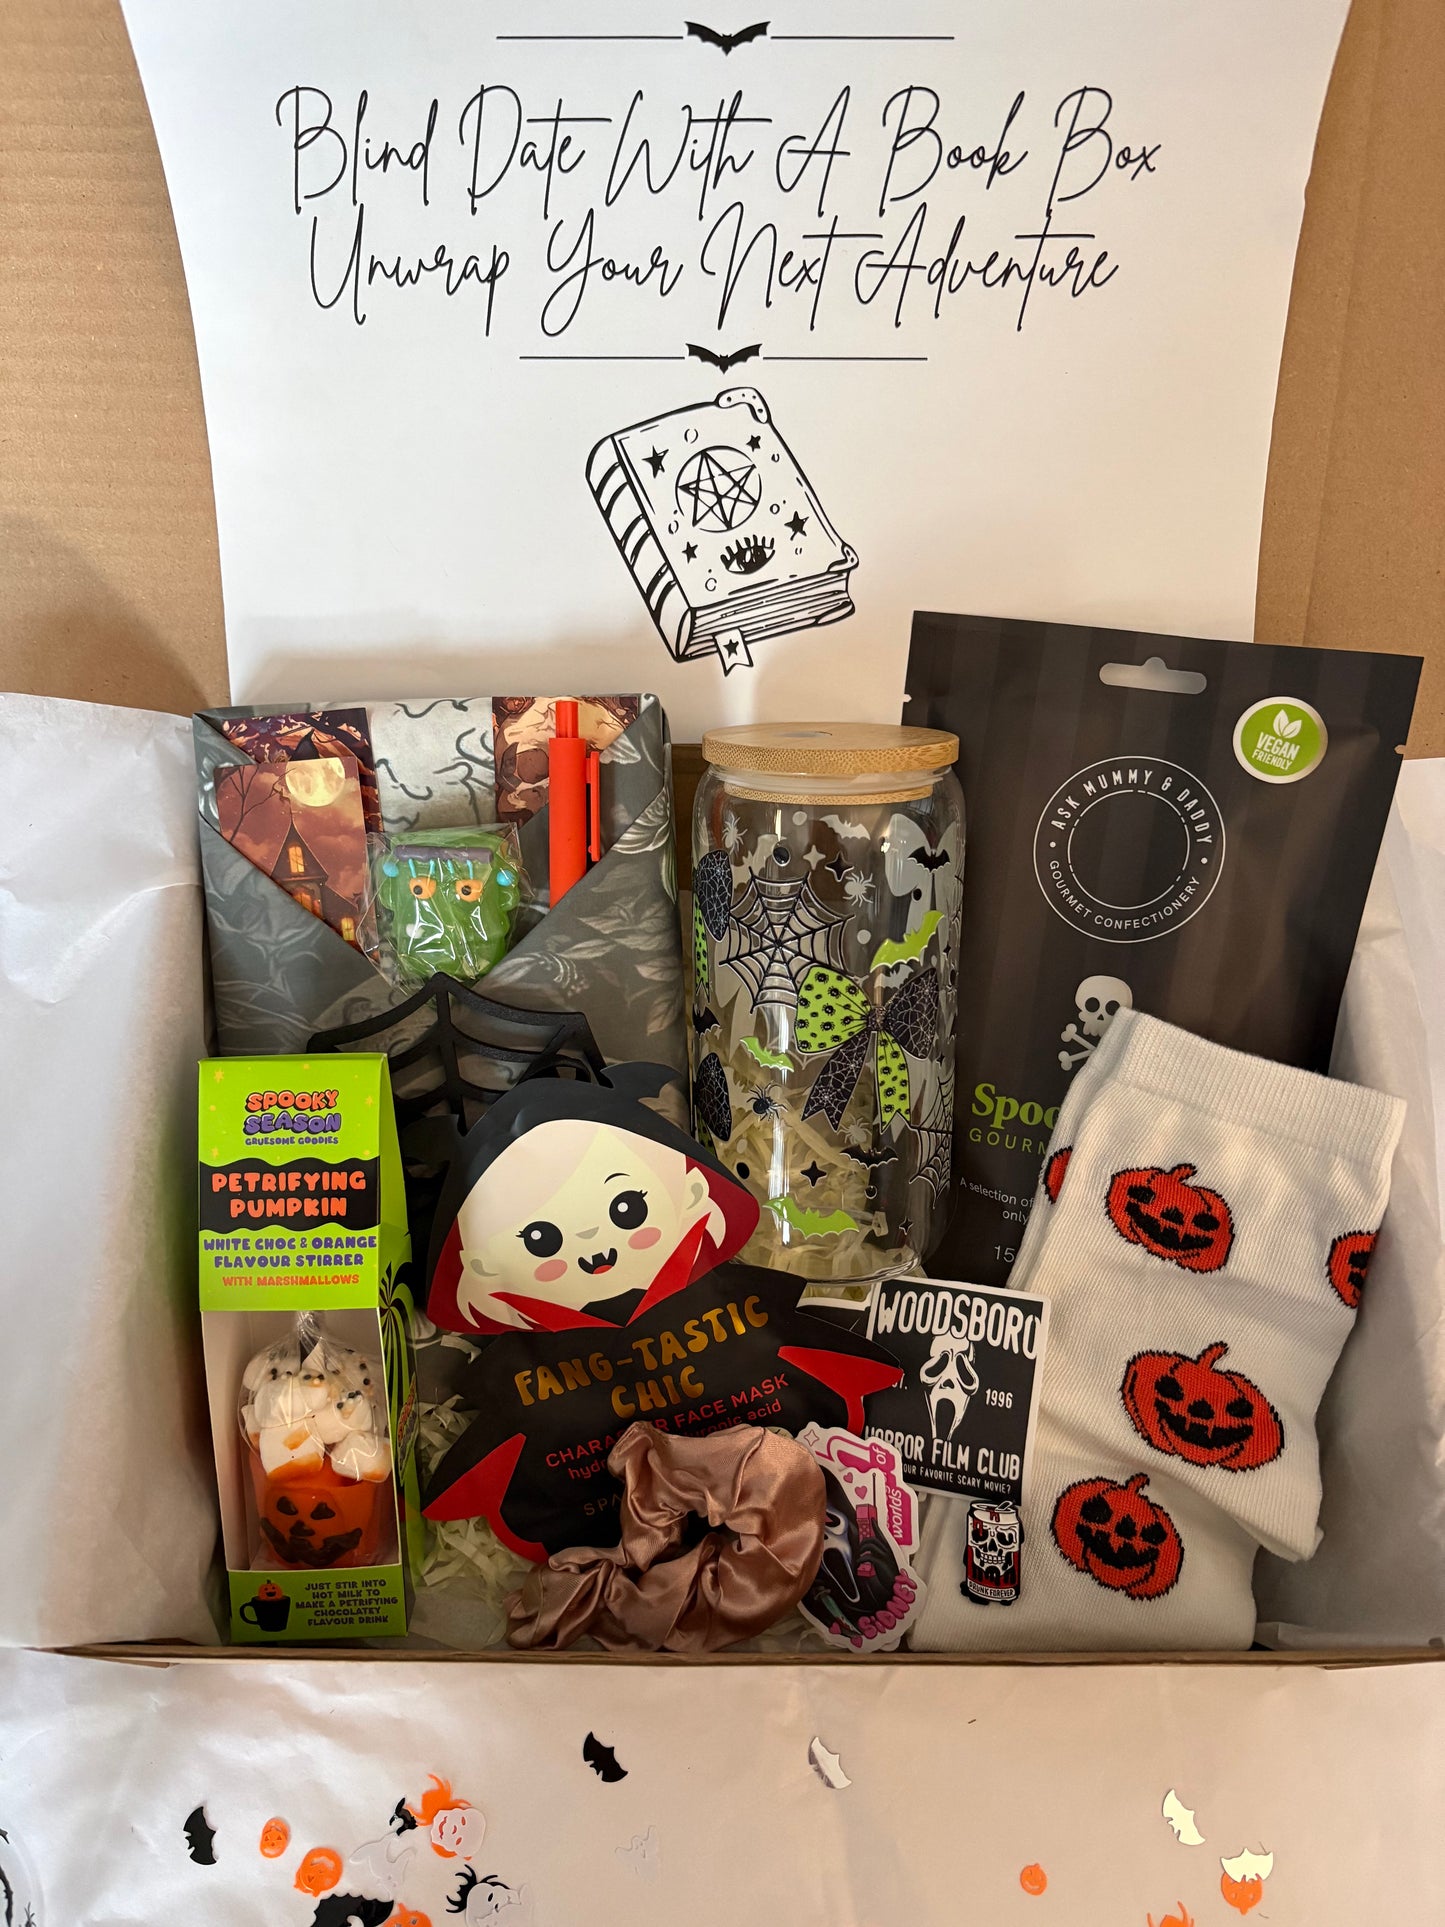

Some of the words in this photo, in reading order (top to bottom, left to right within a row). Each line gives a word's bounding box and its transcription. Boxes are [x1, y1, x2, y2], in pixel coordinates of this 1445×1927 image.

[276, 85, 438, 214] Blind
[459, 85, 611, 219] Date
[605, 90, 773, 220] With
[775, 86, 851, 216] A
[880, 86, 1029, 216] Book
[1045, 86, 1160, 218] Box
[310, 204, 510, 335] Unwrap
[541, 209, 684, 336] Your
[700, 200, 883, 330] Next
[855, 201, 1119, 330] Adventure
[1256, 731, 1300, 761] VEGAN
[1251, 749, 1293, 771] FRIENDLY
[1051, 796, 1080, 830] ASK
[1083, 769, 1152, 796] MUMMY
[1161, 776, 1172, 791] &
[1176, 788, 1212, 844] DADDY
[1049, 860, 1092, 918] GOURMET
[1094, 877, 1200, 930] CONFECTIONERY
[245, 1089, 340, 1112] SPOOKY
[243, 1110, 342, 1135] SEASON
[245, 1137, 295, 1145] GRUESOME
[298, 1136, 339, 1145] GOODIES
[211, 1170, 366, 1193] PETRIFYING
[960, 1176, 968, 1188] A
[968, 1182, 1017, 1205] selection
[230, 1197, 347, 1218] PUMPKIN
[203, 1238, 251, 1251] WHITE
[255, 1238, 296, 1250] CHOC
[300, 1239, 308, 1248] &
[312, 1236, 377, 1249] ORANGE
[994, 1245, 1015, 1263] 15
[214, 1255, 291, 1268] FLAVOUR
[296, 1254, 363, 1267] STIRRER
[222, 1276, 252, 1286] WITH
[257, 1274, 360, 1286] MARSHMALLOWS
[877, 1290, 1042, 1360] WOODSBORO
[514, 1295, 769, 1406] FANG-TASTIC
[611, 1365, 705, 1419] CHIC
[674, 1400, 727, 1428] FACE
[731, 1373, 790, 1409] MASK
[985, 1388, 1013, 1409] 1996
[746, 1398, 782, 1420] acid
[873, 1445, 886, 1465] of
[931, 1438, 970, 1471] FILM
[977, 1447, 1020, 1481] CLUB
[920, 1466, 953, 1483] FAVORITE
[957, 1474, 981, 1488] SCARY
[984, 1482, 1011, 1494] MOVIE?
[891, 1488, 903, 1539] worlds
[305, 1582, 331, 1591] JUST
[335, 1581, 358, 1589] STIR
[361, 1579, 386, 1588] INTO
[312, 1591, 334, 1599] HOT
[337, 1590, 362, 1598] MILK
[366, 1589, 380, 1597] TO
[969, 1581, 989, 1595] DRUNK
[990, 1588, 1013, 1597] FOREVER
[296, 1600, 325, 1609] MAKE
[339, 1597, 398, 1607] PETRIFYING
[314, 1607, 381, 1617] CHOCOLATEY
[308, 1617, 355, 1626] FLAVOUR
[358, 1615, 388, 1624] DRINK
